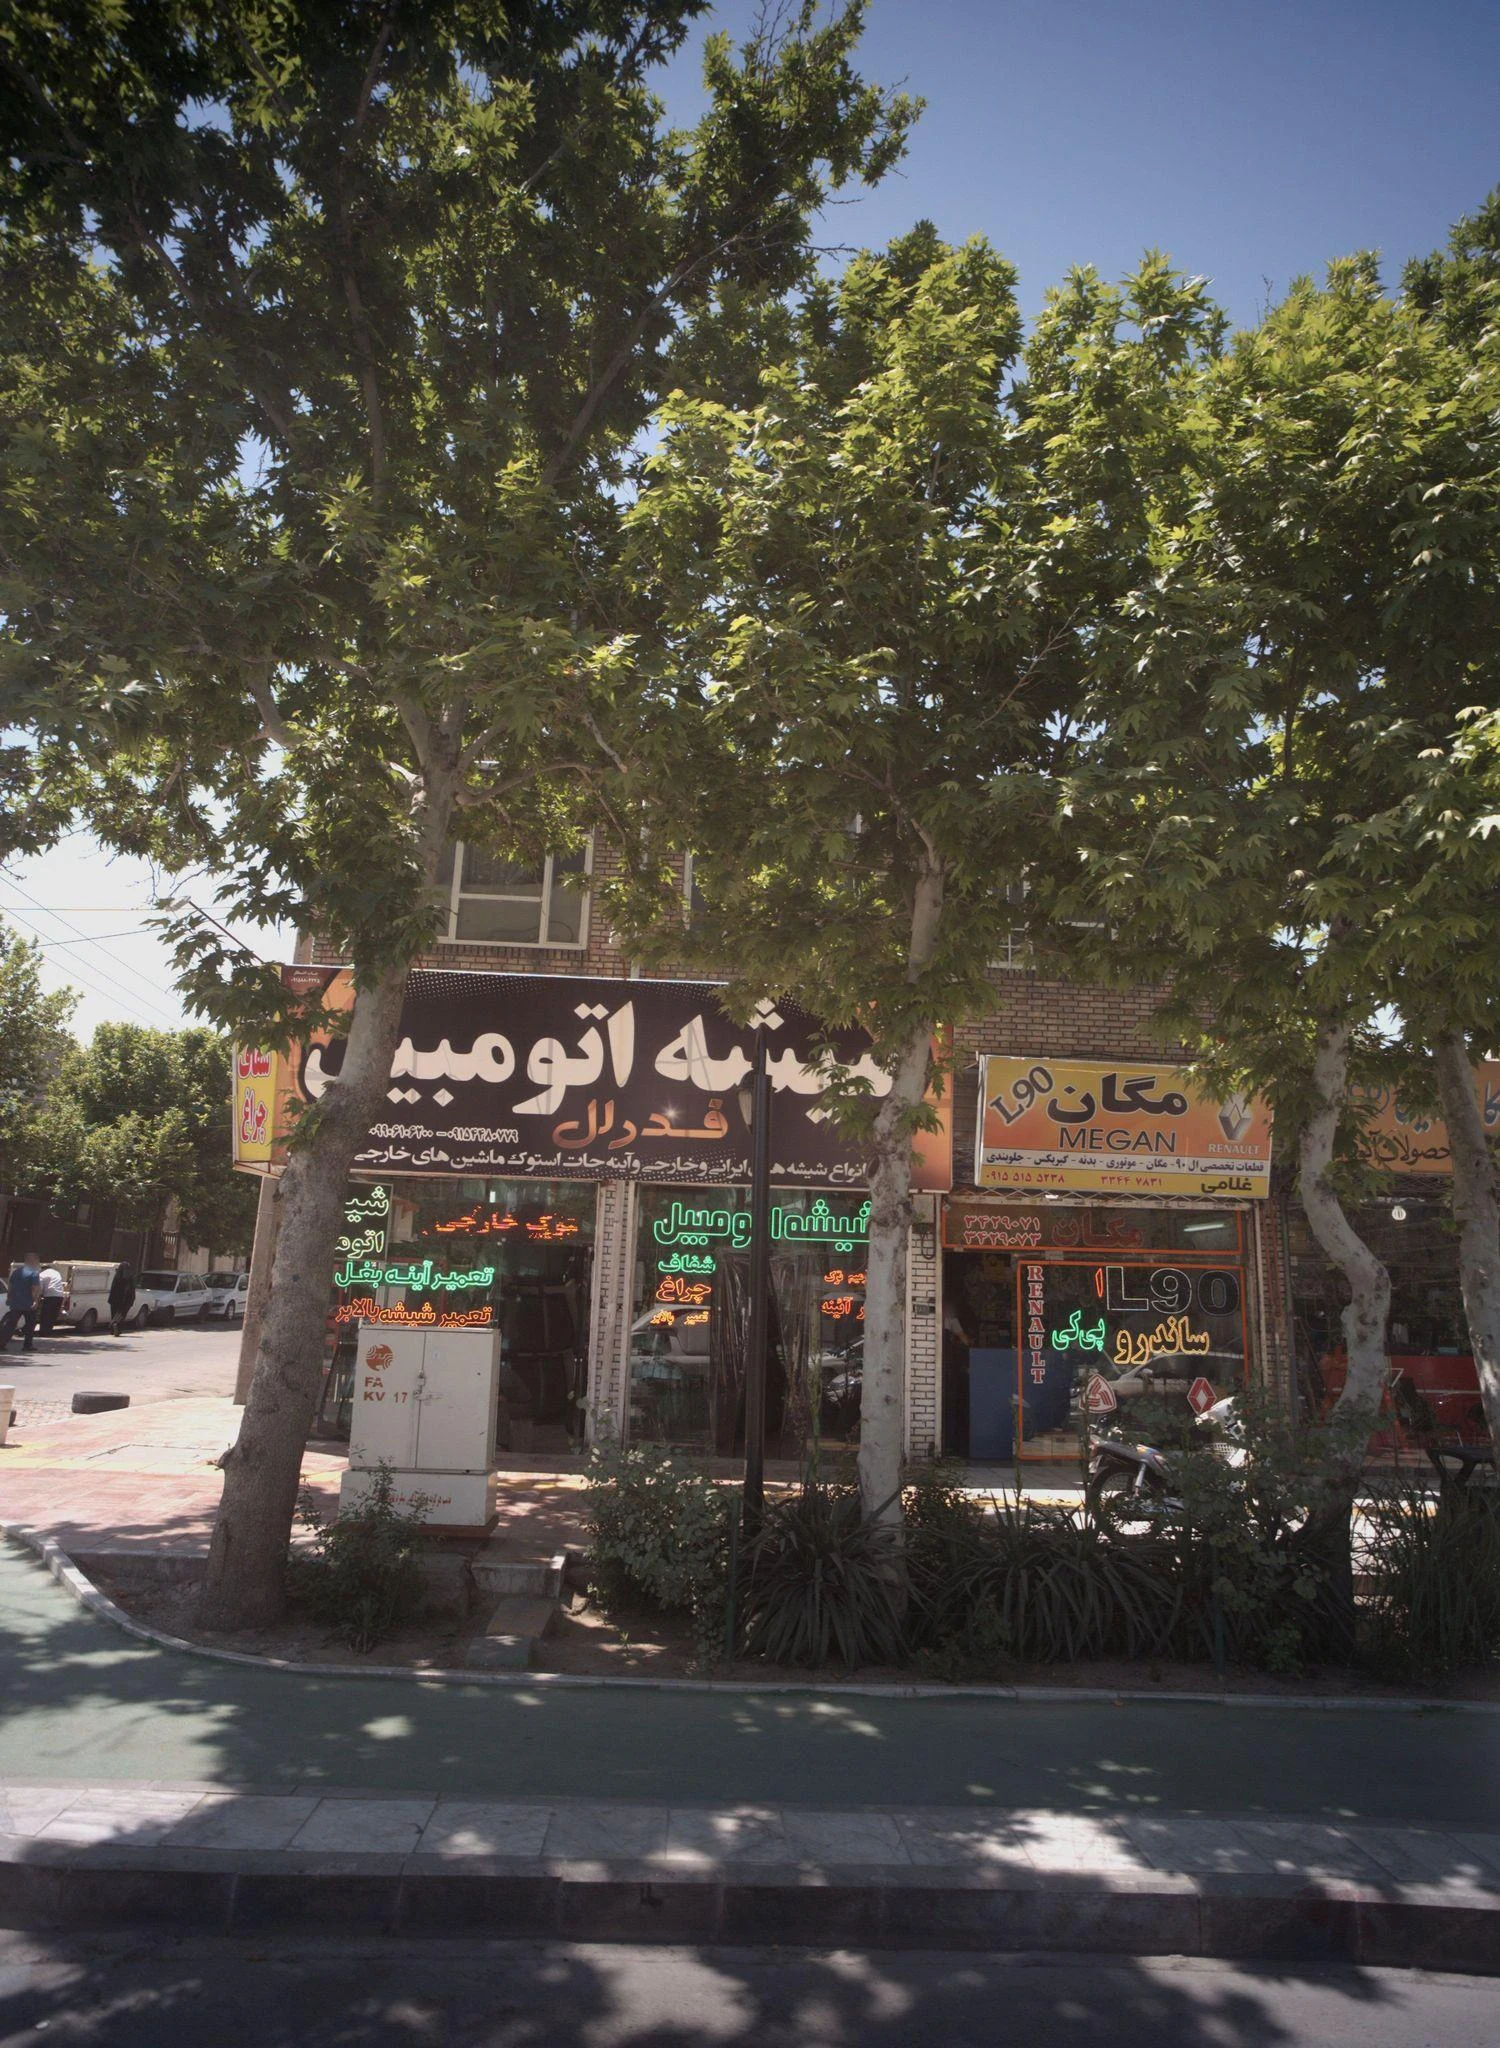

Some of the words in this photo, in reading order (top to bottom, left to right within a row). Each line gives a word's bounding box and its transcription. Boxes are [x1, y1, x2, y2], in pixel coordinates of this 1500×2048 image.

[989, 1066, 1054, 1125] L90
[1047, 1073, 1188, 1124] مگان
[241, 1087, 268, 1143] چراغ
[552, 1098, 728, 1150] فدرال
[1058, 1127, 1176, 1152] MEGAN
[1208, 1143, 1260, 1155] RENAULT
[354, 1145, 411, 1163] خارجی
[412, 1146, 449, 1165] های
[450, 1149, 506, 1169] ماشین
[787, 1162, 828, 1181] شیشه
[1201, 1177, 1252, 1194] غلامی
[344, 1186, 389, 1222] شی
[654, 1202, 782, 1248] اومبیل
[335, 1229, 385, 1259] اتوم
[335, 1259, 383, 1288] بغل
[385, 1259, 433, 1291] آینه
[658, 1252, 716, 1273] شفاف
[430, 1267, 495, 1291] تعمیر
[656, 1275, 712, 1304] چراغ
[1106, 1266, 1241, 1318] L90
[335, 1298, 379, 1323] بالابر
[379, 1301, 436, 1327] شیشه
[438, 1306, 493, 1328] تعمیر
[1027, 1265, 1045, 1385] RENAULT
[1113, 1316, 1210, 1365] ساندرو
[364, 1376, 383, 1388] FA
[363, 1391, 386, 1402] KV
[393, 1392, 408, 1403] 17
